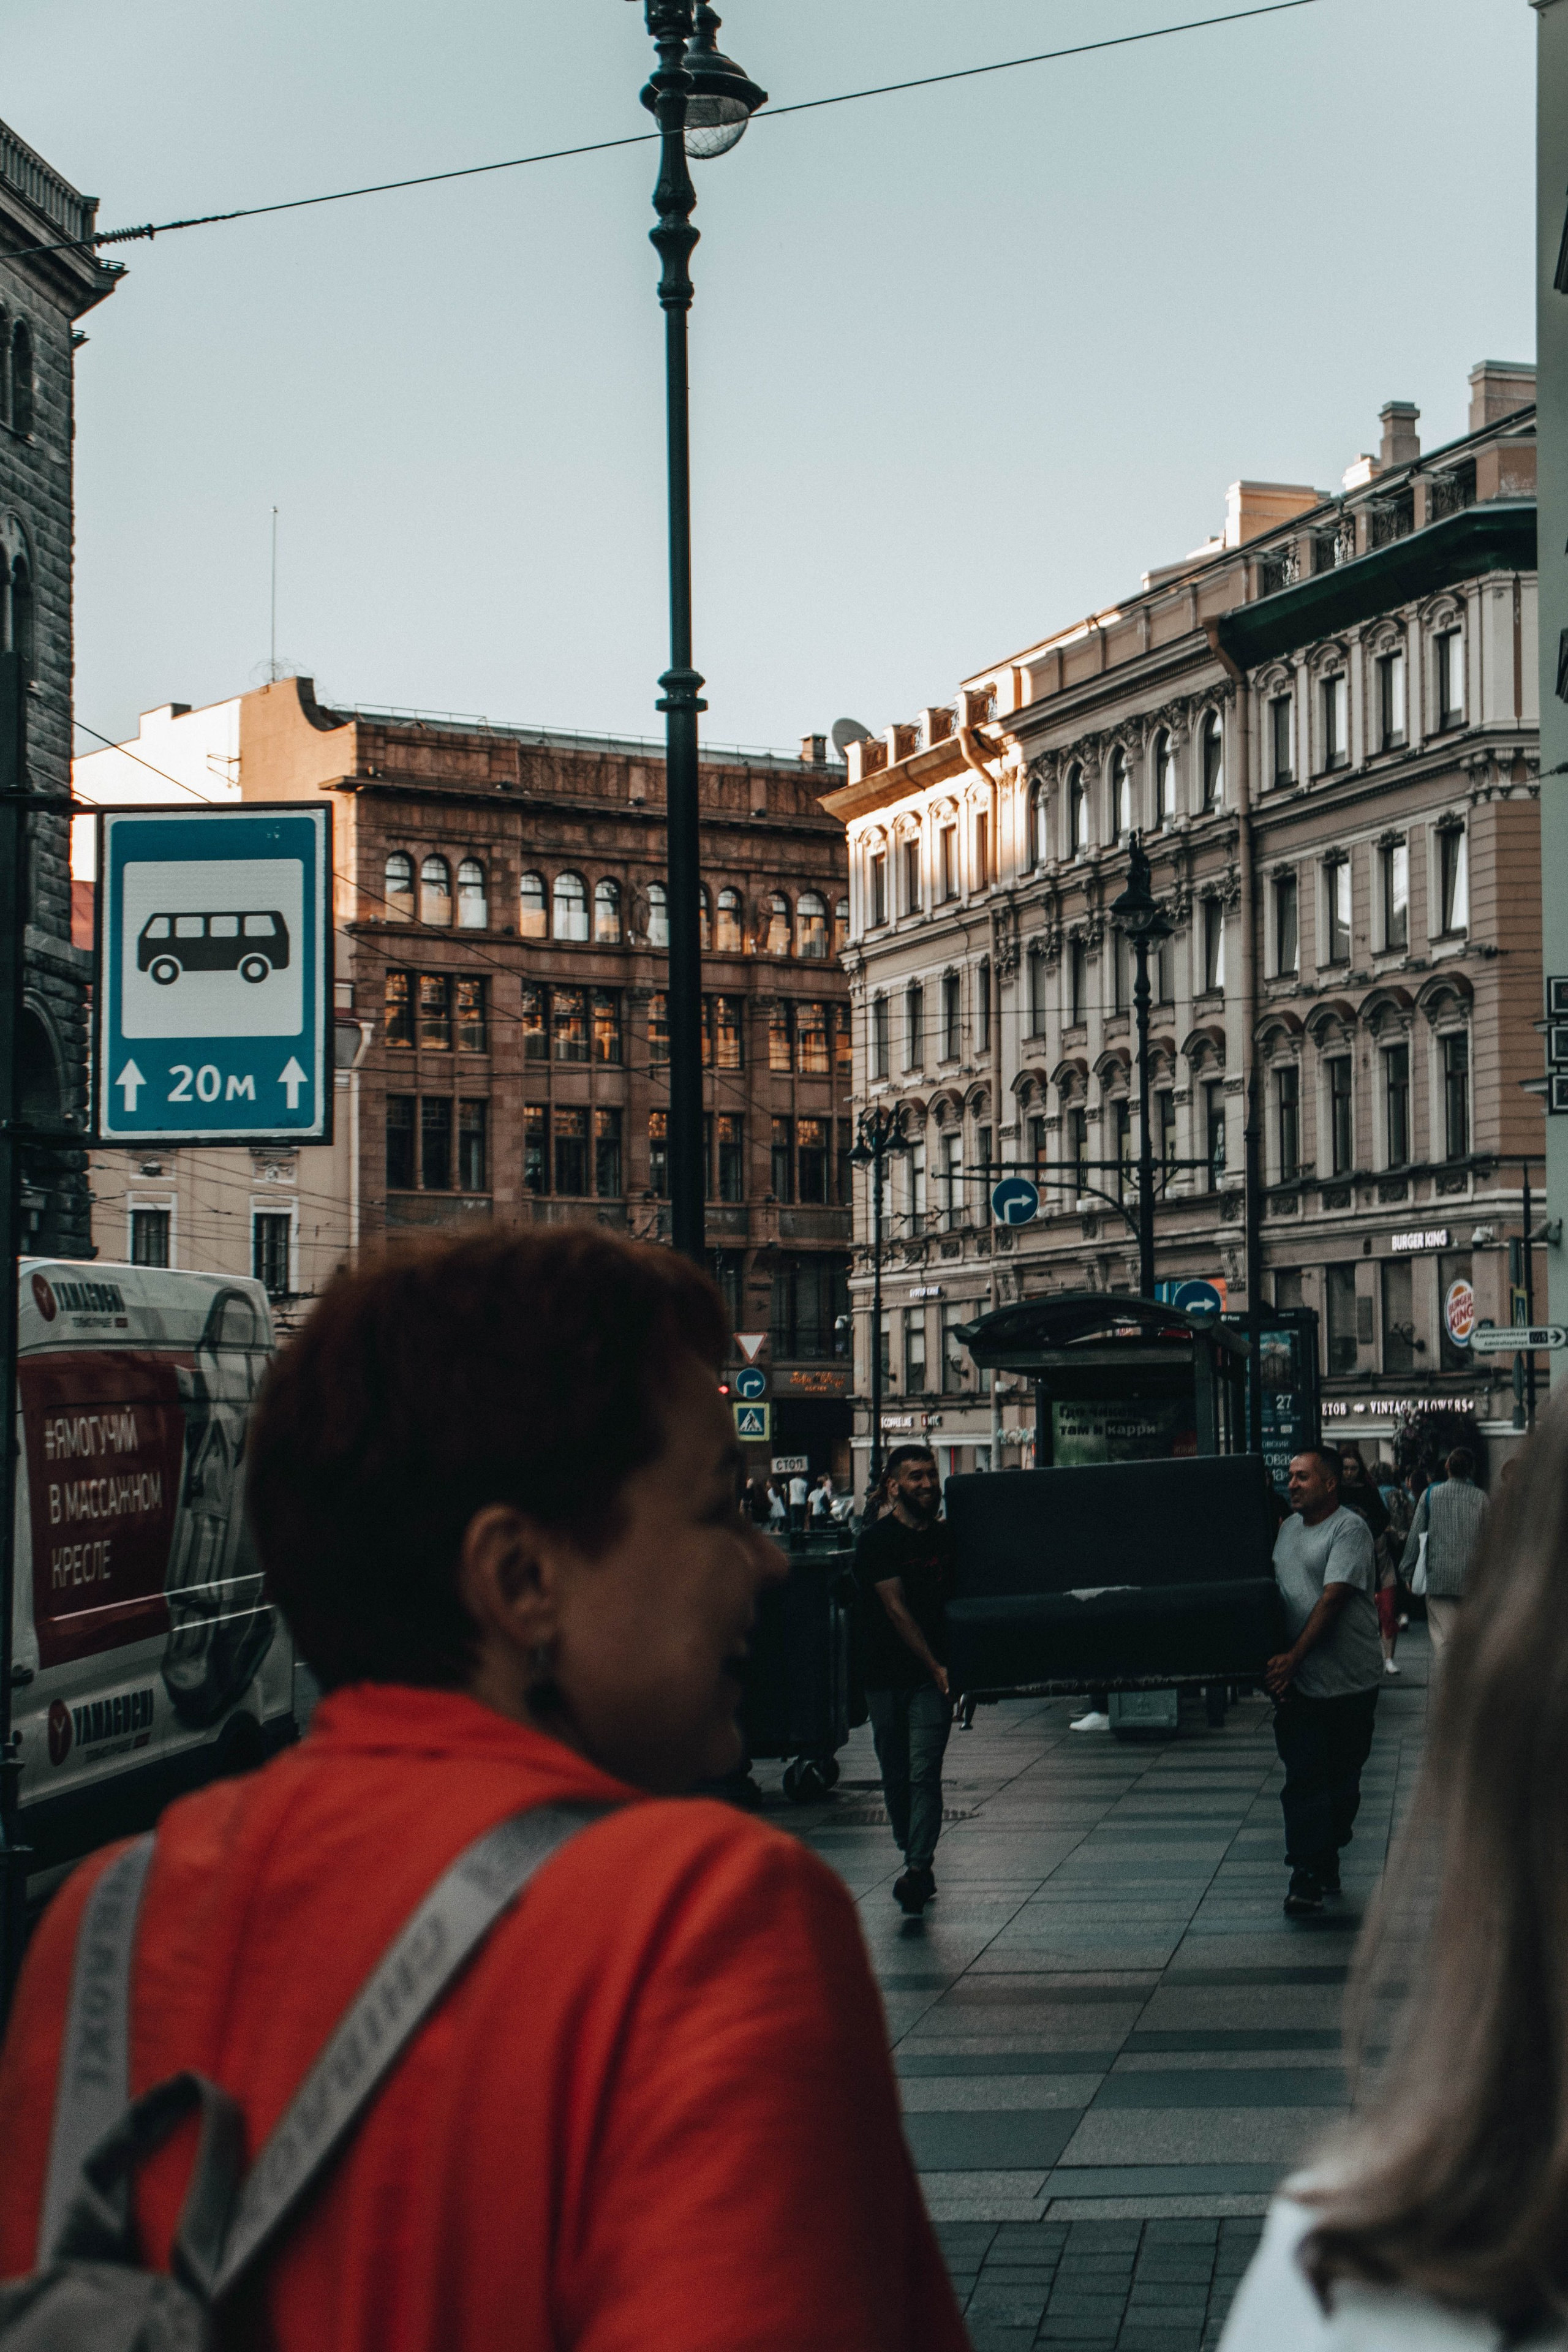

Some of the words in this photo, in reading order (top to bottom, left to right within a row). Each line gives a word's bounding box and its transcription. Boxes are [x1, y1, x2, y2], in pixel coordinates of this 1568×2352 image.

[1392, 1232, 1425, 1251] BURGER
[1425, 1229, 1447, 1248] KING
[51, 1282, 126, 1312] YAMAGUCHI
[1448, 1292, 1472, 1314] BURGER
[1450, 1303, 1474, 1330] KING
[1275, 1394, 1292, 1410] 27
[44, 1406, 138, 1460] #ЯМОГУЧИЙ
[1059, 1425, 1089, 1435] там
[1107, 1424, 1156, 1438] карри
[776, 1458, 803, 1471] СТОП
[48, 1483, 61, 1525] В
[64, 1471, 163, 1522] МАССАЖНОМ
[51, 1539, 111, 1589] КРЕСЛЕ
[72, 1688, 153, 1747] YAMAGUCHI
